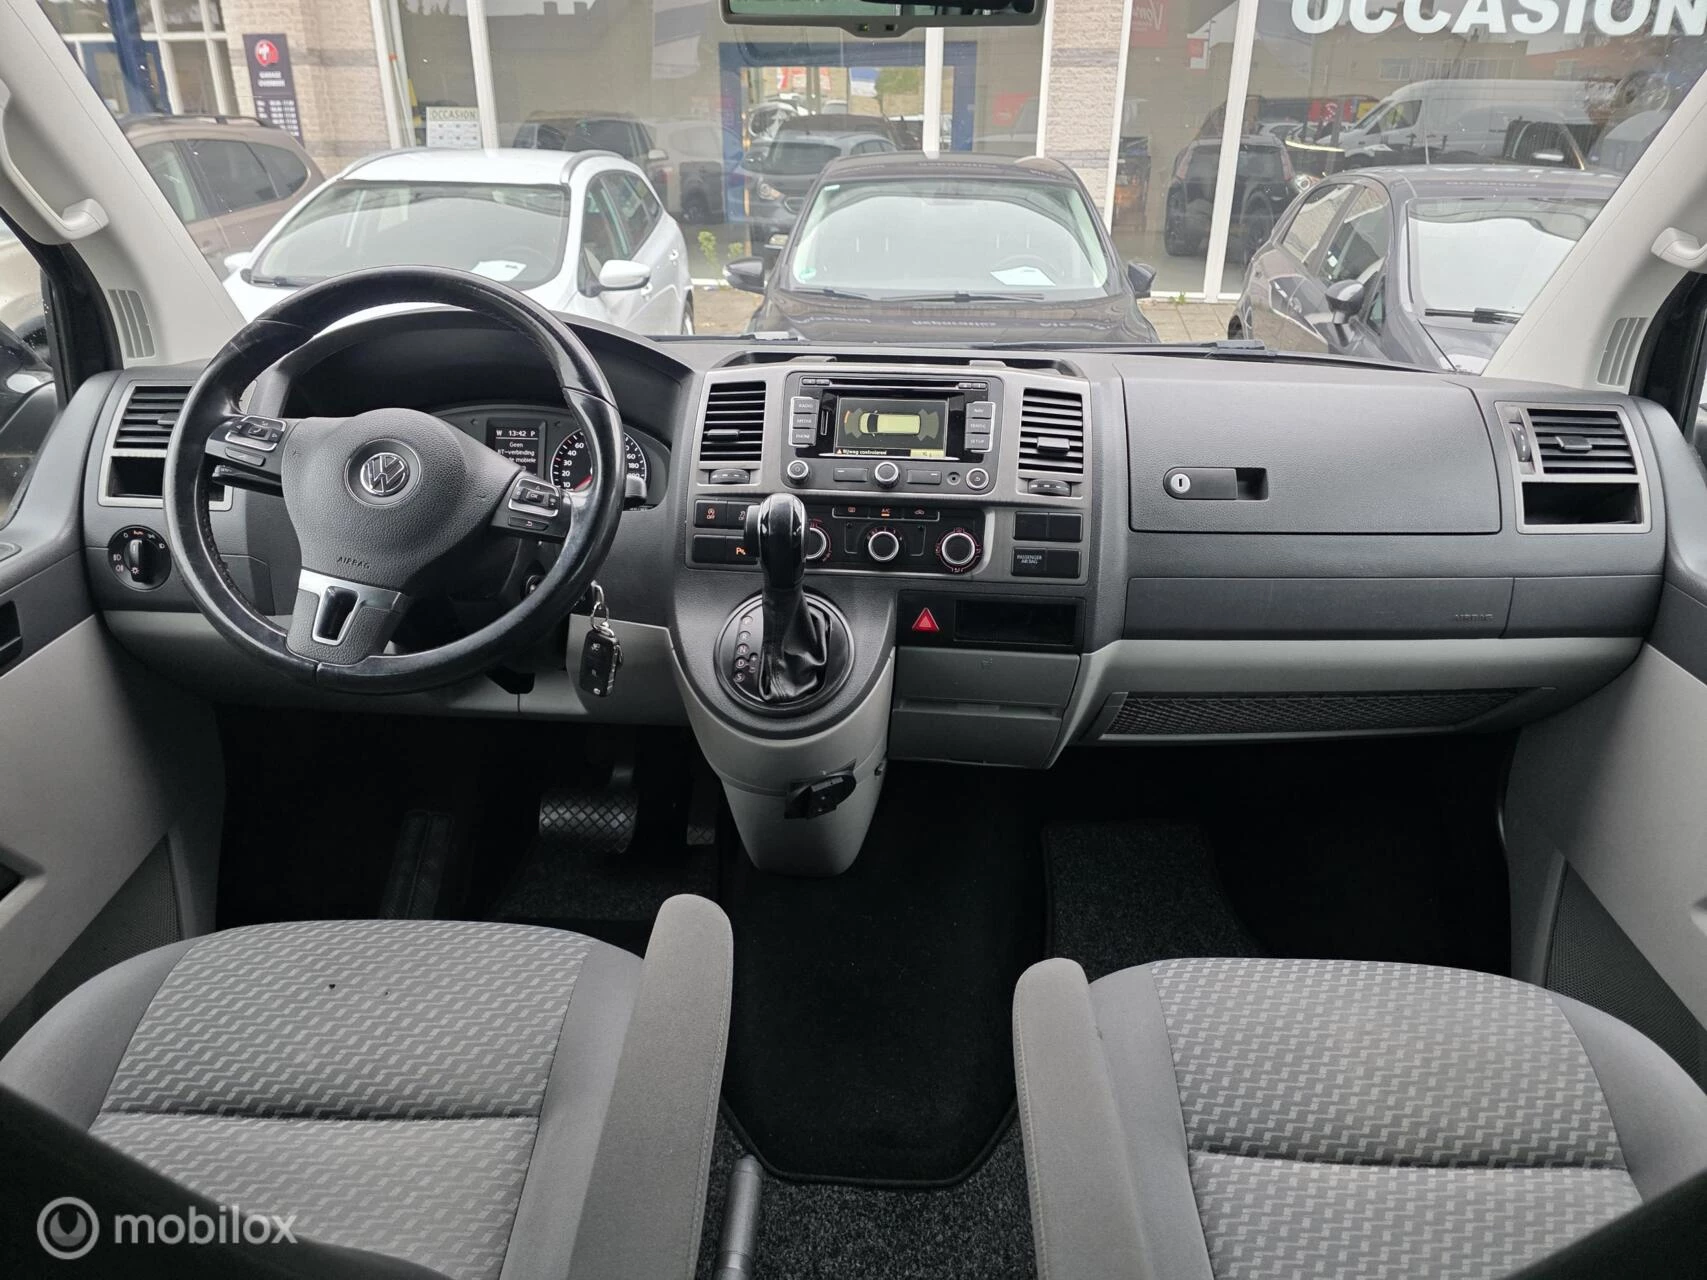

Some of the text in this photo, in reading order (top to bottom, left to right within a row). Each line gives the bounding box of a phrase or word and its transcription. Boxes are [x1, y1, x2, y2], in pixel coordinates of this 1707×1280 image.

[1291, 0, 1707, 36] OCCASION
[430, 109, 478, 120] OCCASION
[337, 557, 370, 569] AIRBAG
